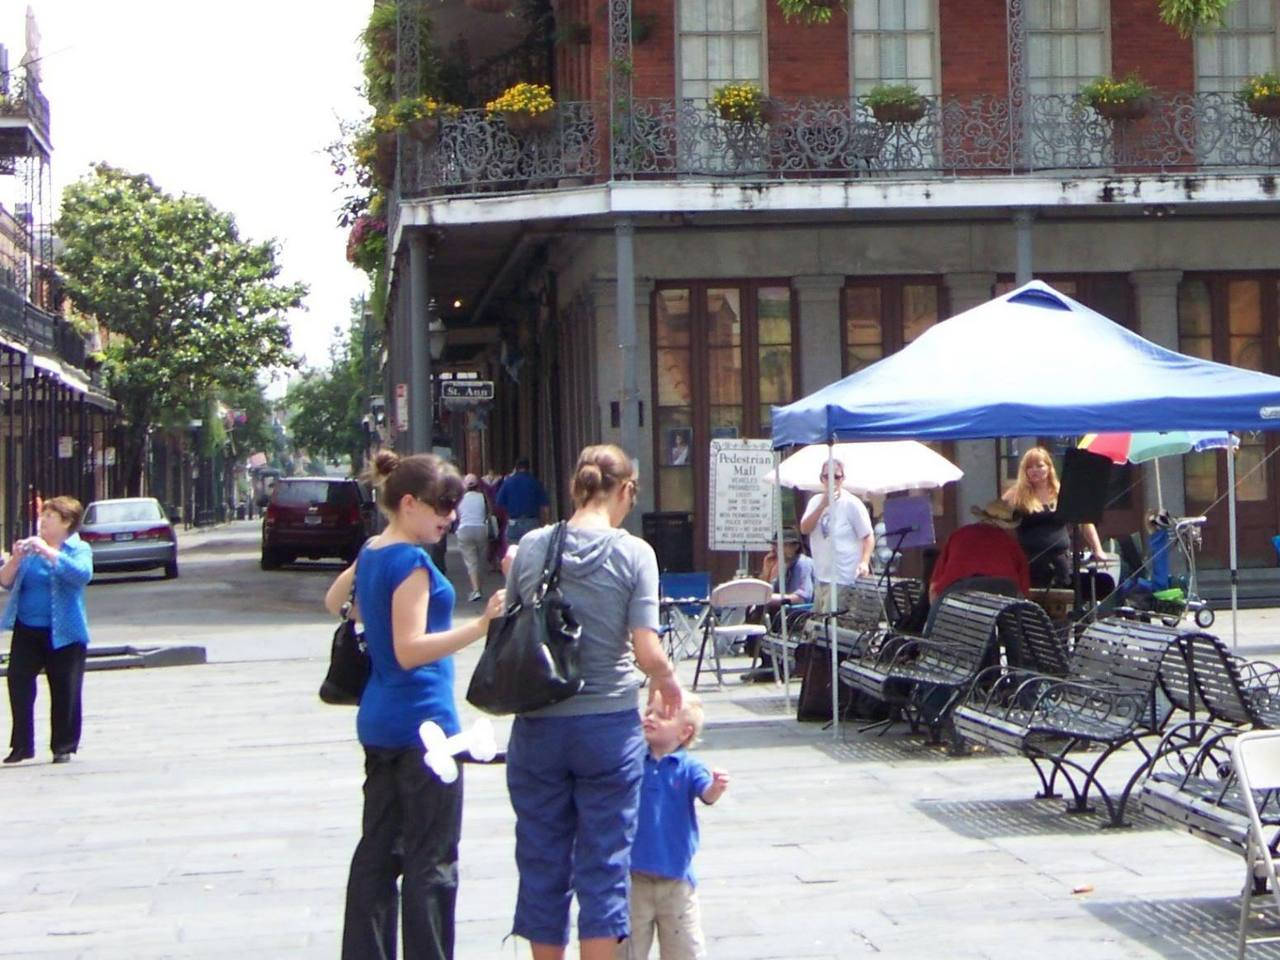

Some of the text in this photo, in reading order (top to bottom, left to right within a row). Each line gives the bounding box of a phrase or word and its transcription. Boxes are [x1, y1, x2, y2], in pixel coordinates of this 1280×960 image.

[447, 387, 488, 396] St. Ann
[719, 452, 771, 464] Pedestrian
[734, 465, 756, 476] Mall
